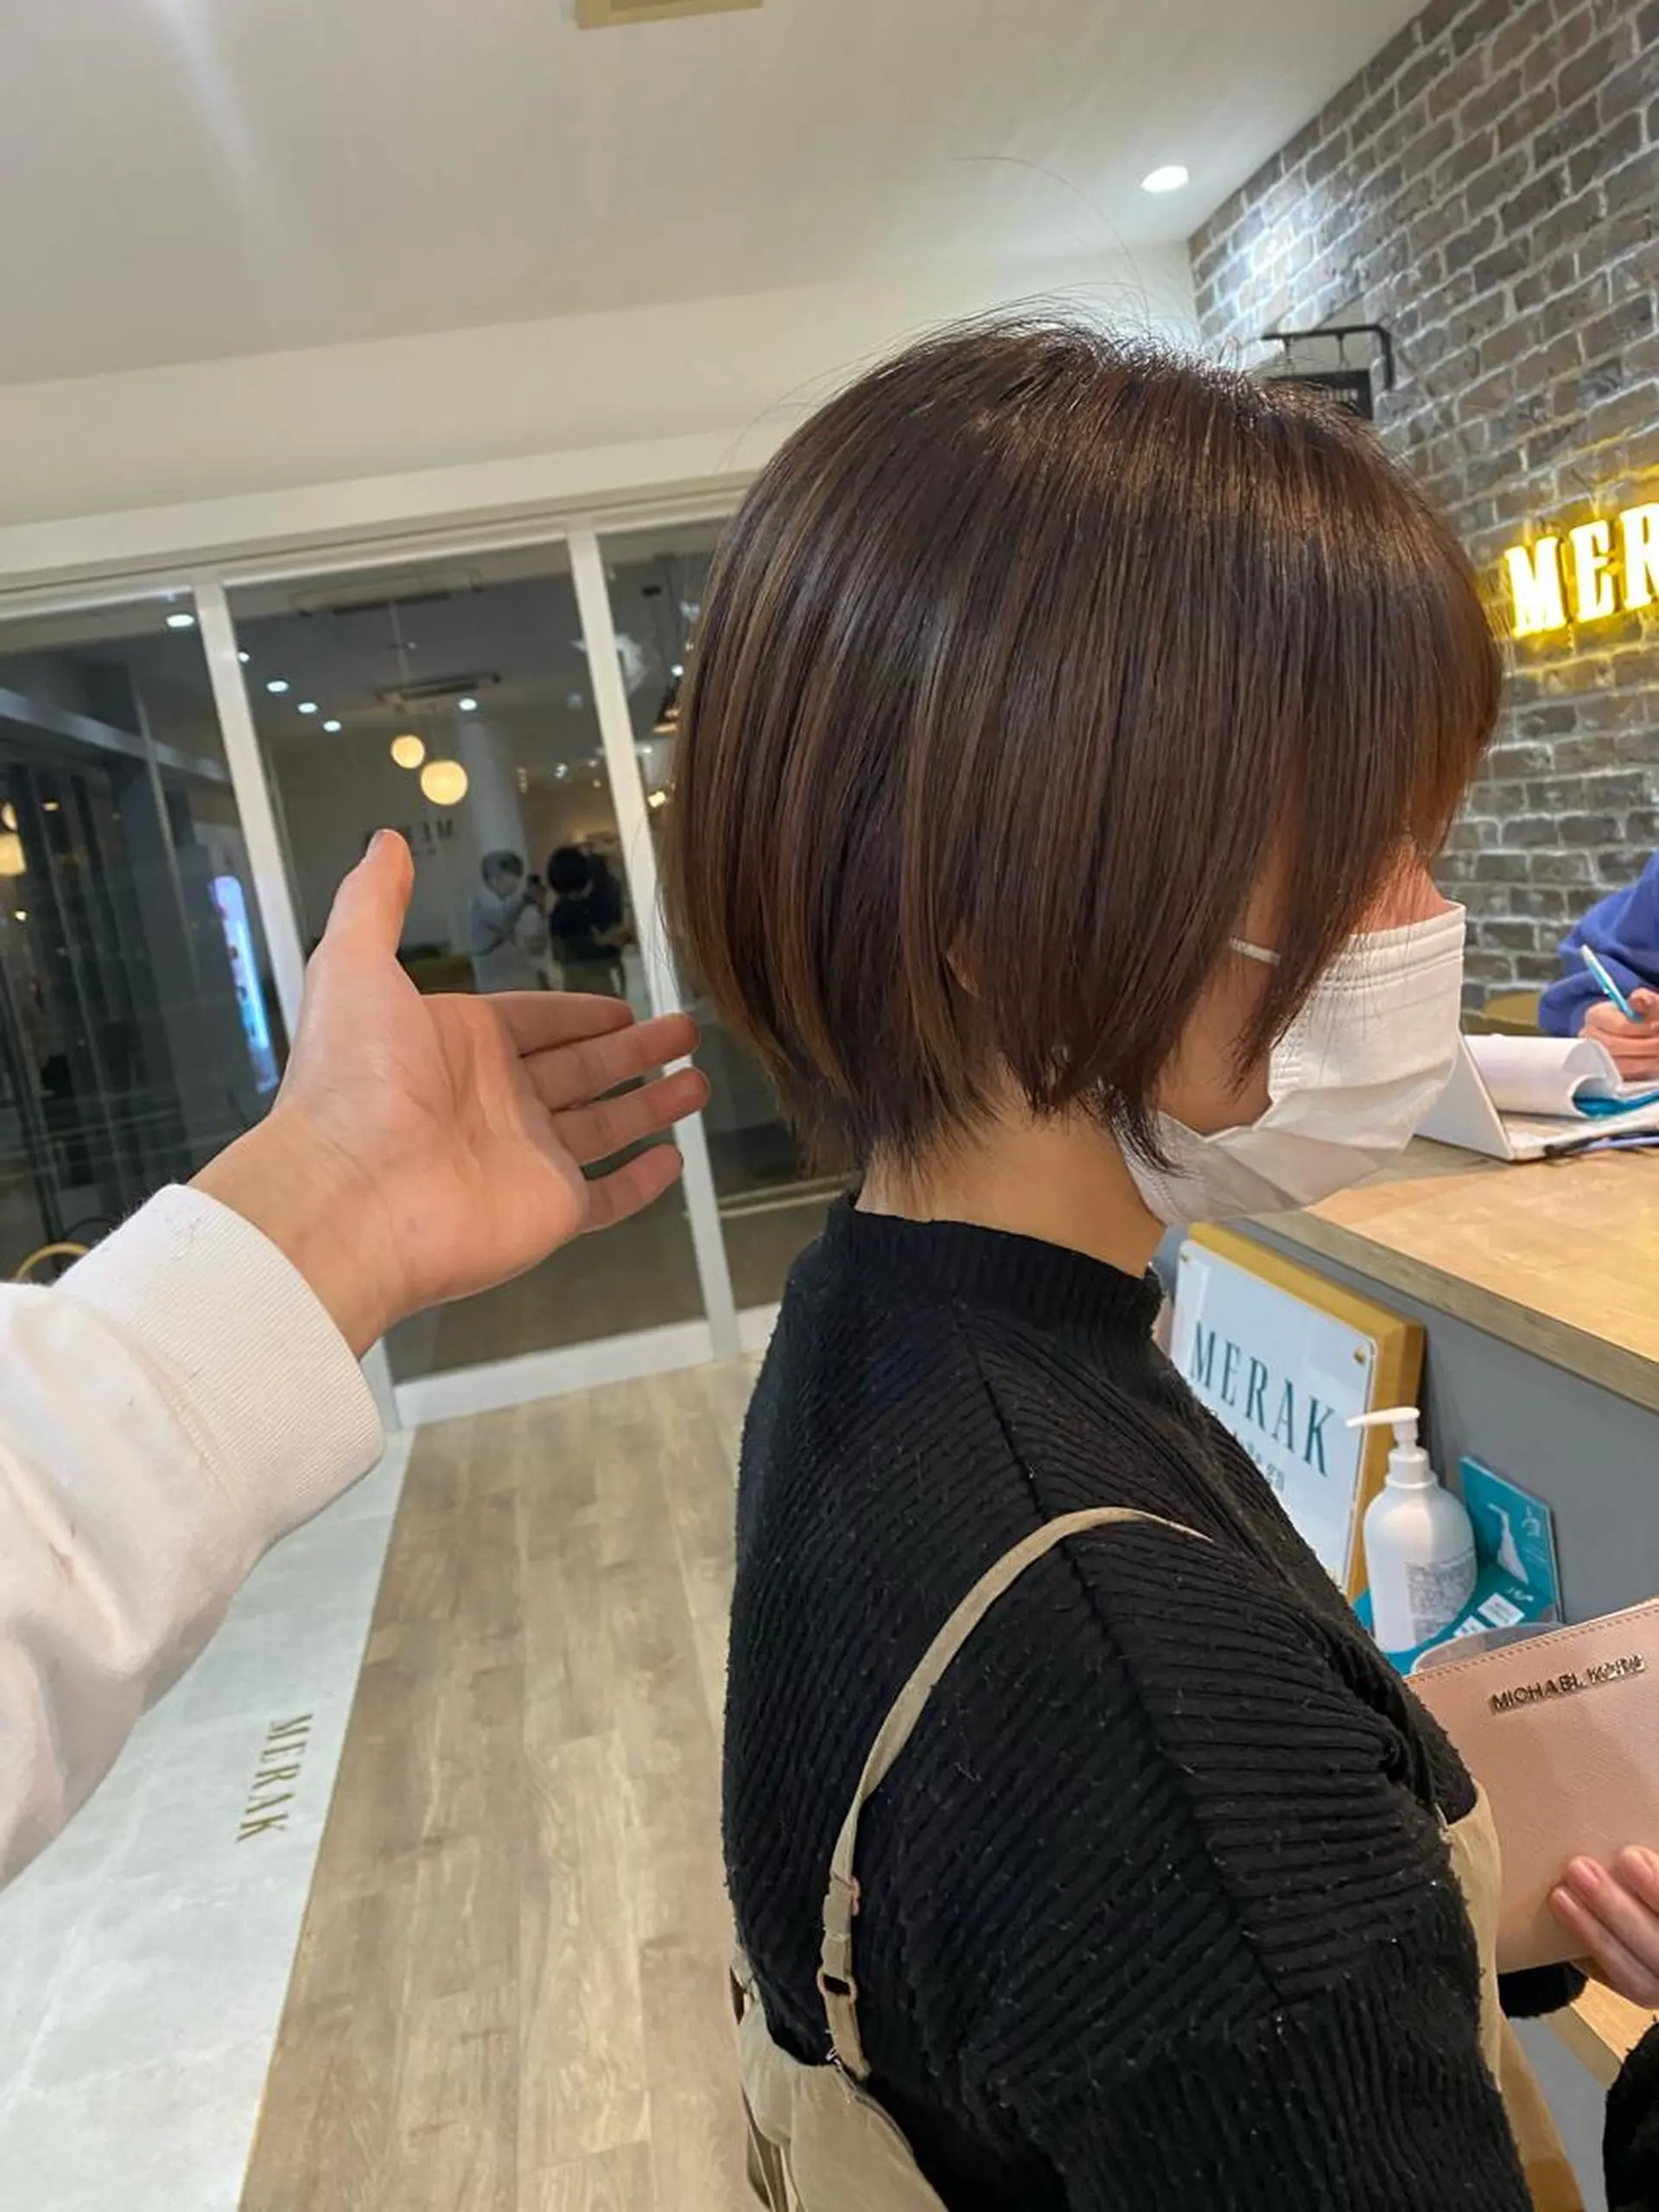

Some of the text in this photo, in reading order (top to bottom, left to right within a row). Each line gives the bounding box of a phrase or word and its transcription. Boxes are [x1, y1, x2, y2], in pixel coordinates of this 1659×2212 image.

[1191, 1321, 1336, 1478] MERAK
[1490, 1672, 1586, 1715] MICHAEL
[234, 1713, 313, 1844] MERAK
